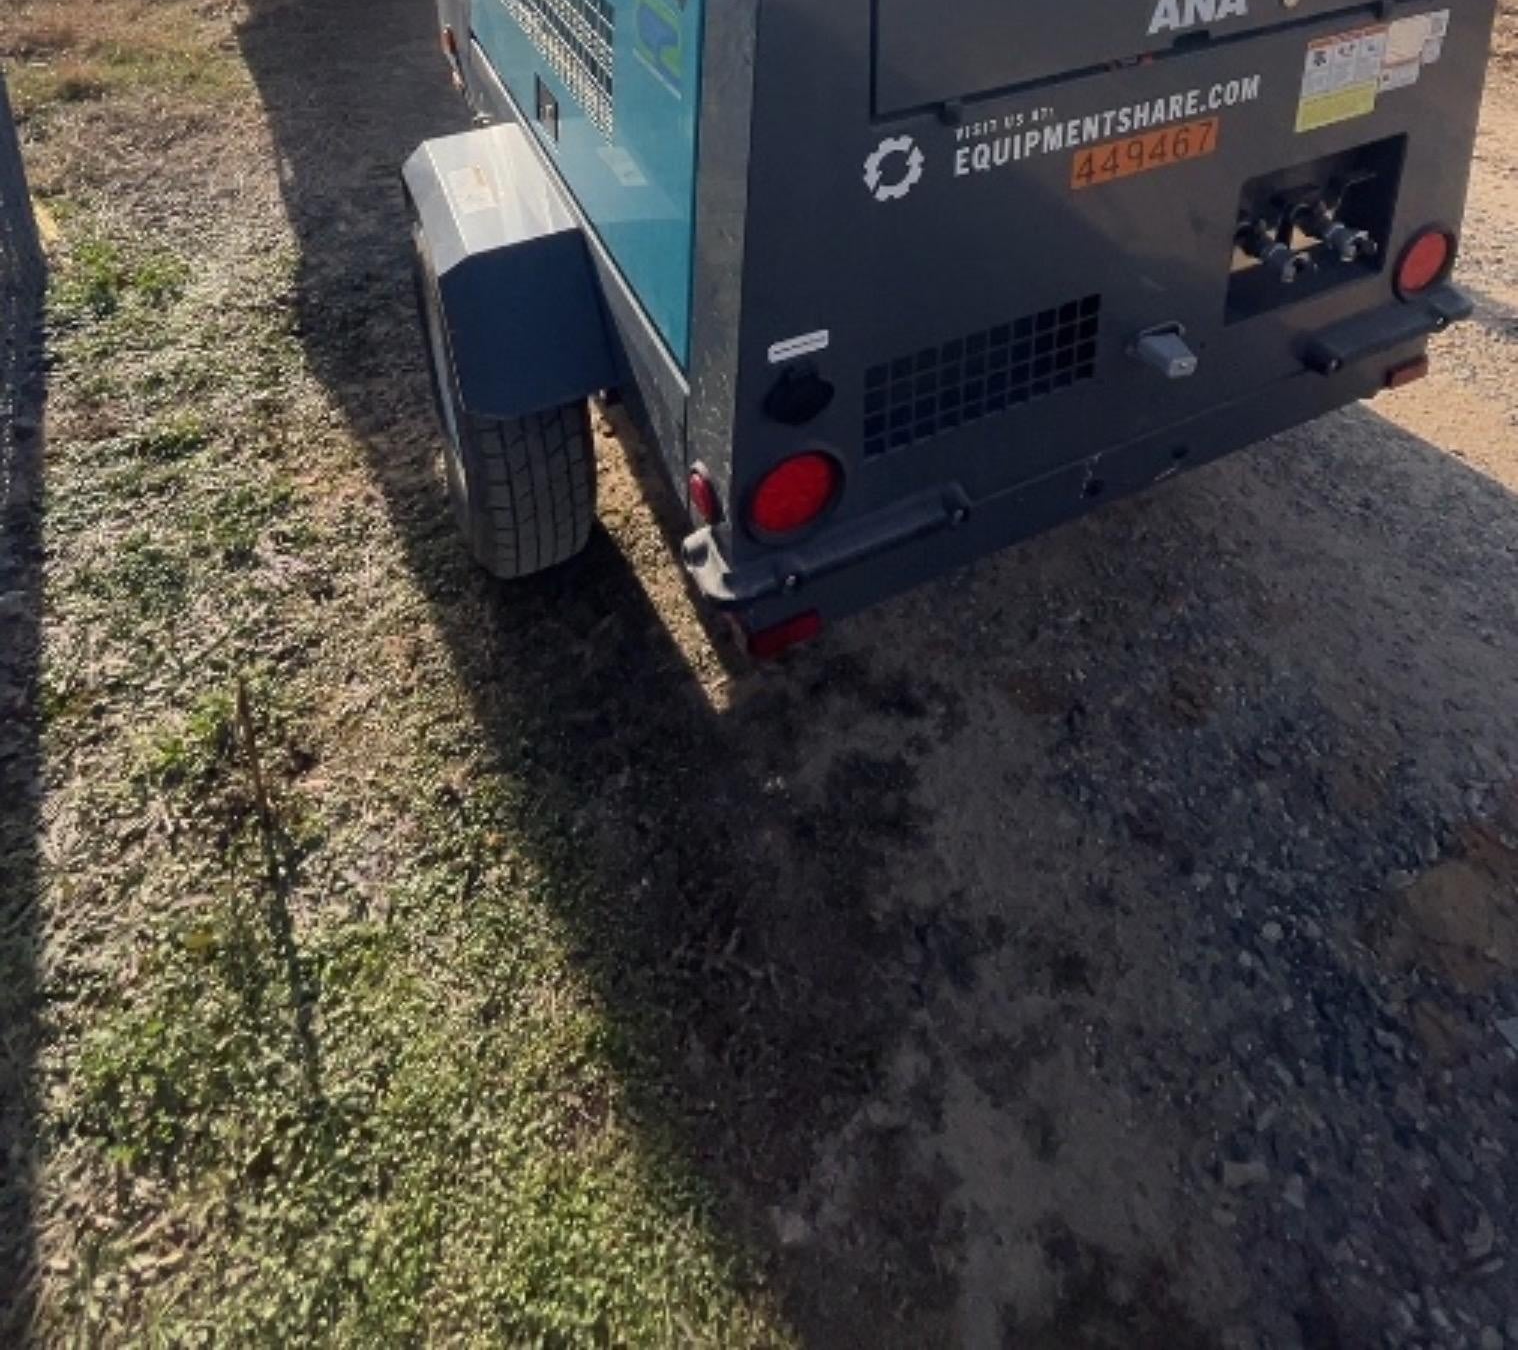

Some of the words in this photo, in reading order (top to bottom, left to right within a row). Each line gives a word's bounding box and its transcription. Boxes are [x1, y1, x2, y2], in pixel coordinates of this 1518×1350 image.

[953, 74, 1261, 176] EQUIPMENTSHARE.COM
[954, 119, 998, 142] VISIT
[1004, 113, 1025, 130] US
[1076, 121, 1213, 184] 449467
